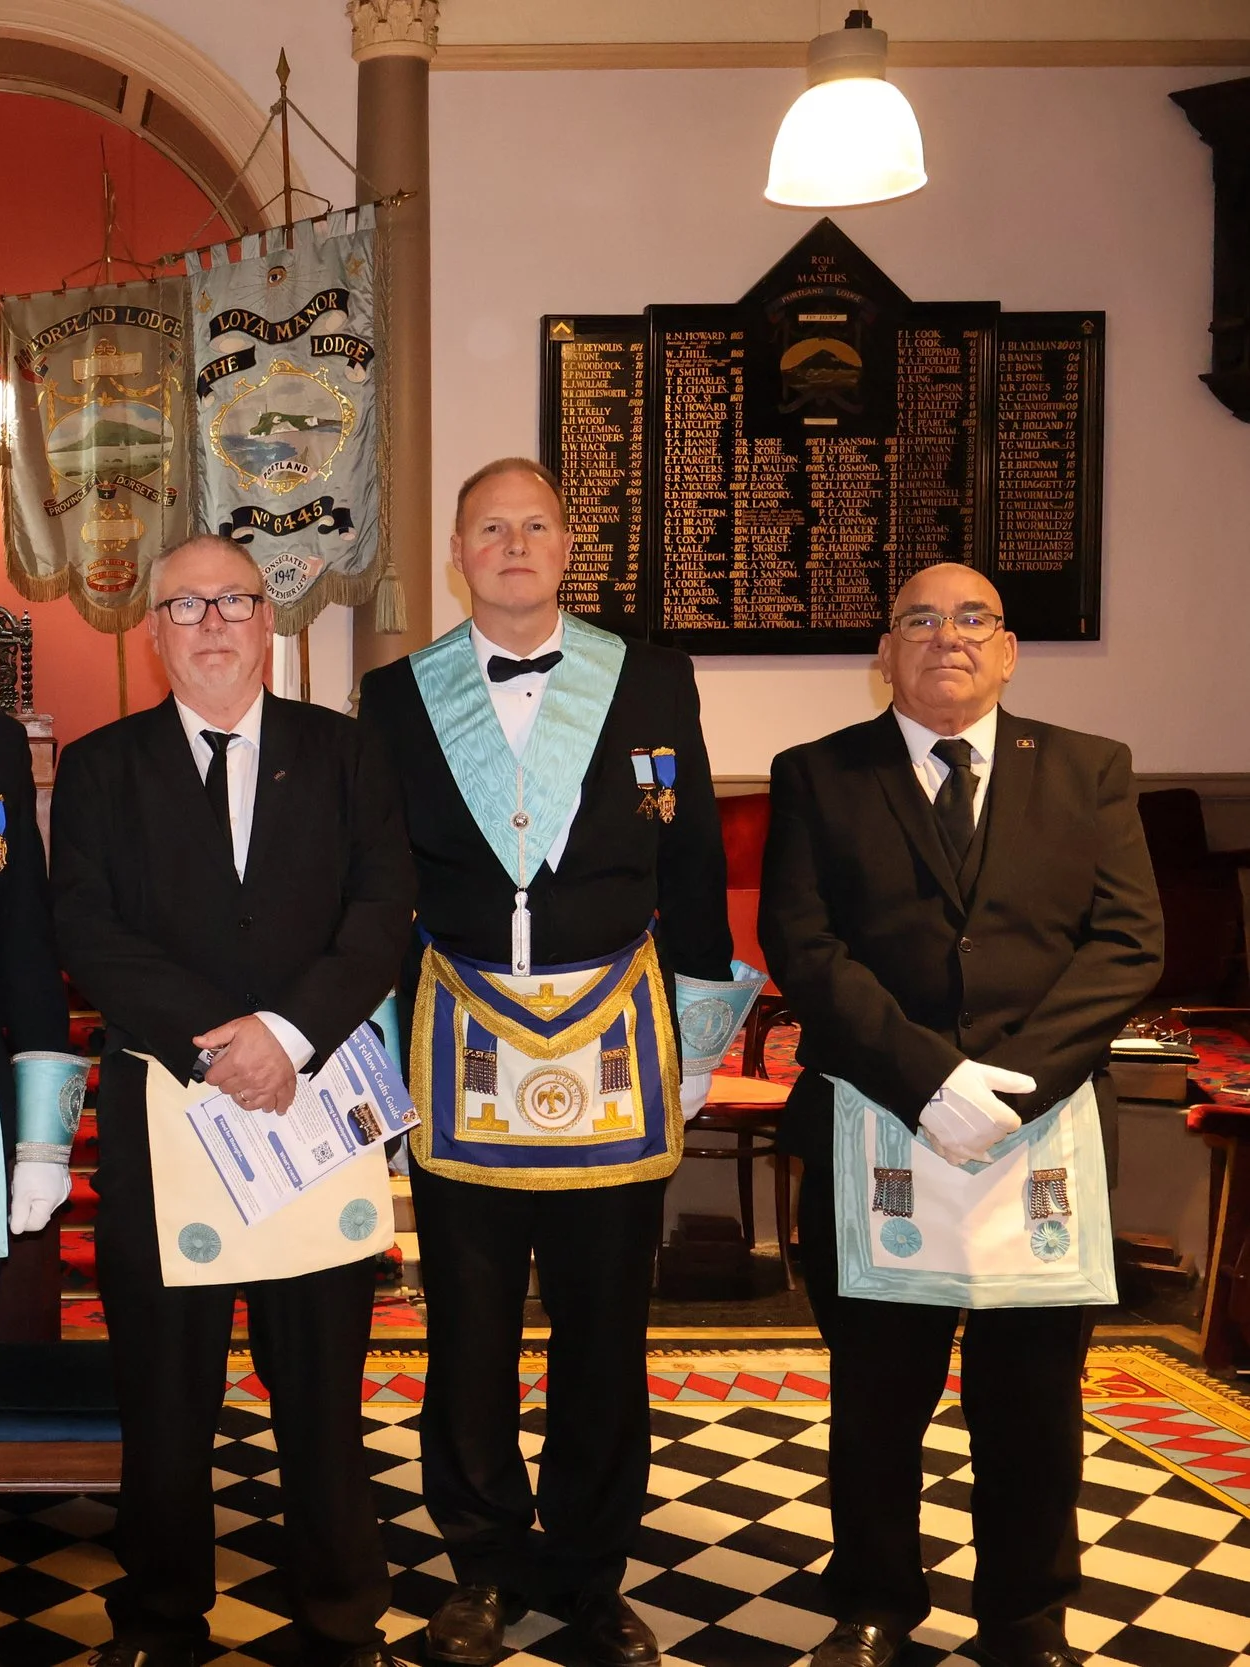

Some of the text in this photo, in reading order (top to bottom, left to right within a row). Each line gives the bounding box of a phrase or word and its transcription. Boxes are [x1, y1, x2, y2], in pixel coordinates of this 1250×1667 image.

[797, 274, 847, 282] MASTERS
[31, 308, 184, 352] PORTLAND LODGE
[276, 292, 338, 341] MANOR
[202, 336, 368, 383] THE LODGE
[263, 462, 308, 480] PORTLAND
[49, 486, 88, 516] PROVINCE
[274, 501, 323, 534] 6445
[274, 568, 296, 585] 1947
[614, 582, 636, 591] 2000
[349, 1030, 401, 1120] he Fellow Crafts Guide
